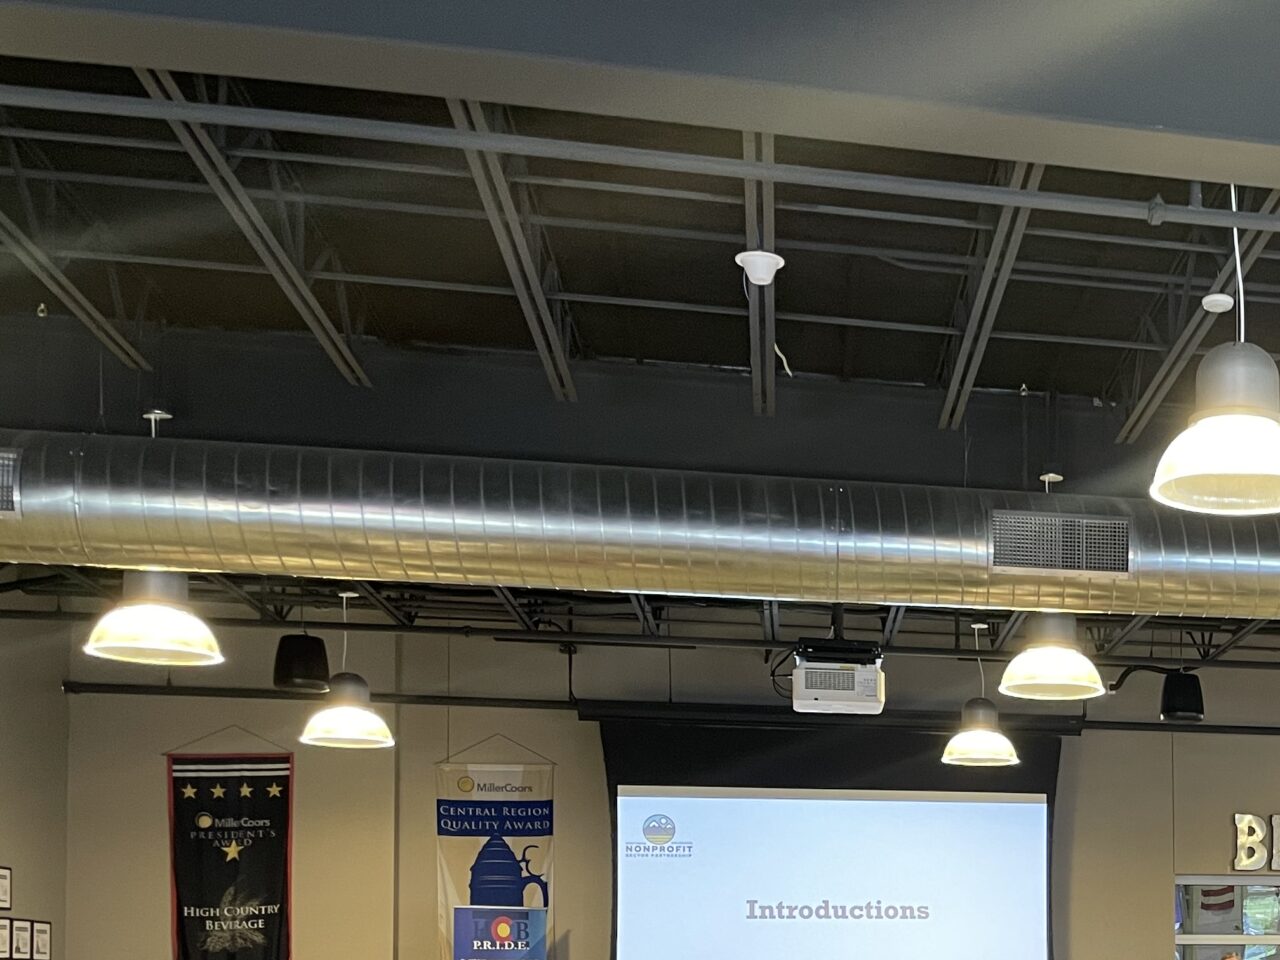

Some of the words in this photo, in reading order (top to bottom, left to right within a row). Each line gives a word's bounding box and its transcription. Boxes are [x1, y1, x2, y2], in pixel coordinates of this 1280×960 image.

[477, 783, 533, 793] MillerCoors
[440, 805, 497, 816] CENTRAL
[502, 806, 550, 816] REGION
[214, 817, 271, 828] MilleCoors
[441, 819, 499, 831] QUALITY
[503, 820, 550, 830] AWARD
[190, 829, 276, 839] PRESIDENT'S
[212, 838, 253, 847] AWD
[625, 845, 693, 853] NONPROFIT
[183, 906, 220, 917] HIGH
[223, 904, 280, 917] COUNTRY
[745, 899, 930, 920] Introductions
[473, 940, 530, 951] P.R.I.D.E.
